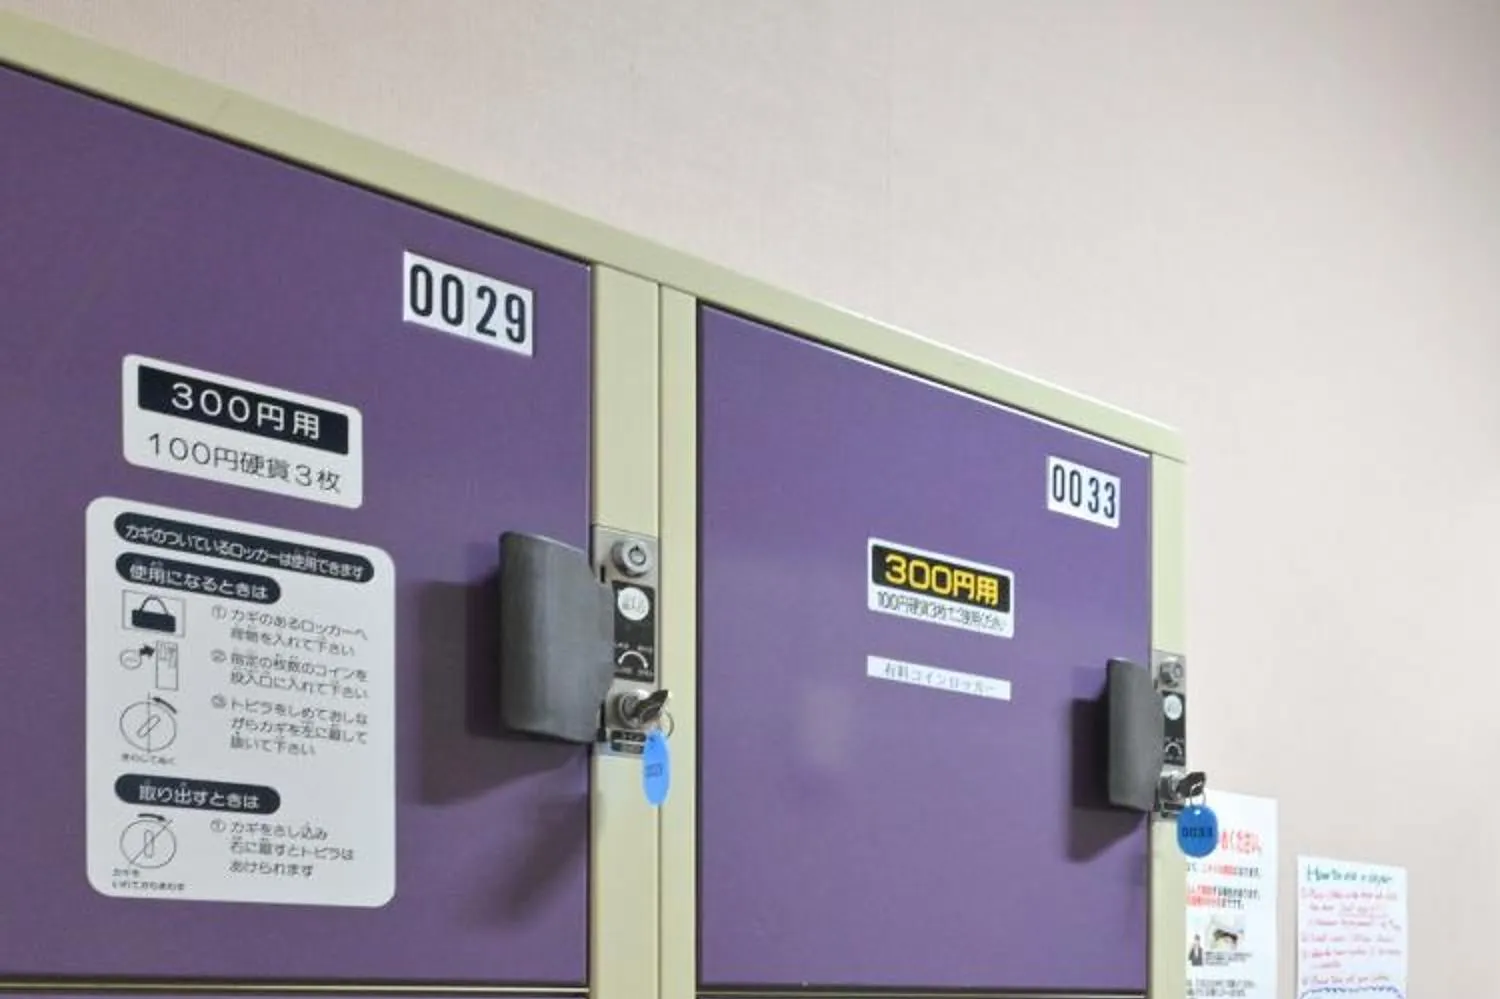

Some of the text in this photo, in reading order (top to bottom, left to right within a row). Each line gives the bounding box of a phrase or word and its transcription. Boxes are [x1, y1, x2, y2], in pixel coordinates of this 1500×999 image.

[408, 263, 527, 344] 0029
[170, 382, 322, 441] 300円用
[148, 431, 343, 494] 100円硬貨3枚
[1052, 464, 1116, 519] 0033
[125, 524, 365, 580] カギのついているロッカーは使用できます
[130, 562, 268, 600] 使用になるときは
[884, 553, 999, 607] 300円用
[138, 784, 260, 809] 取り出すときは
